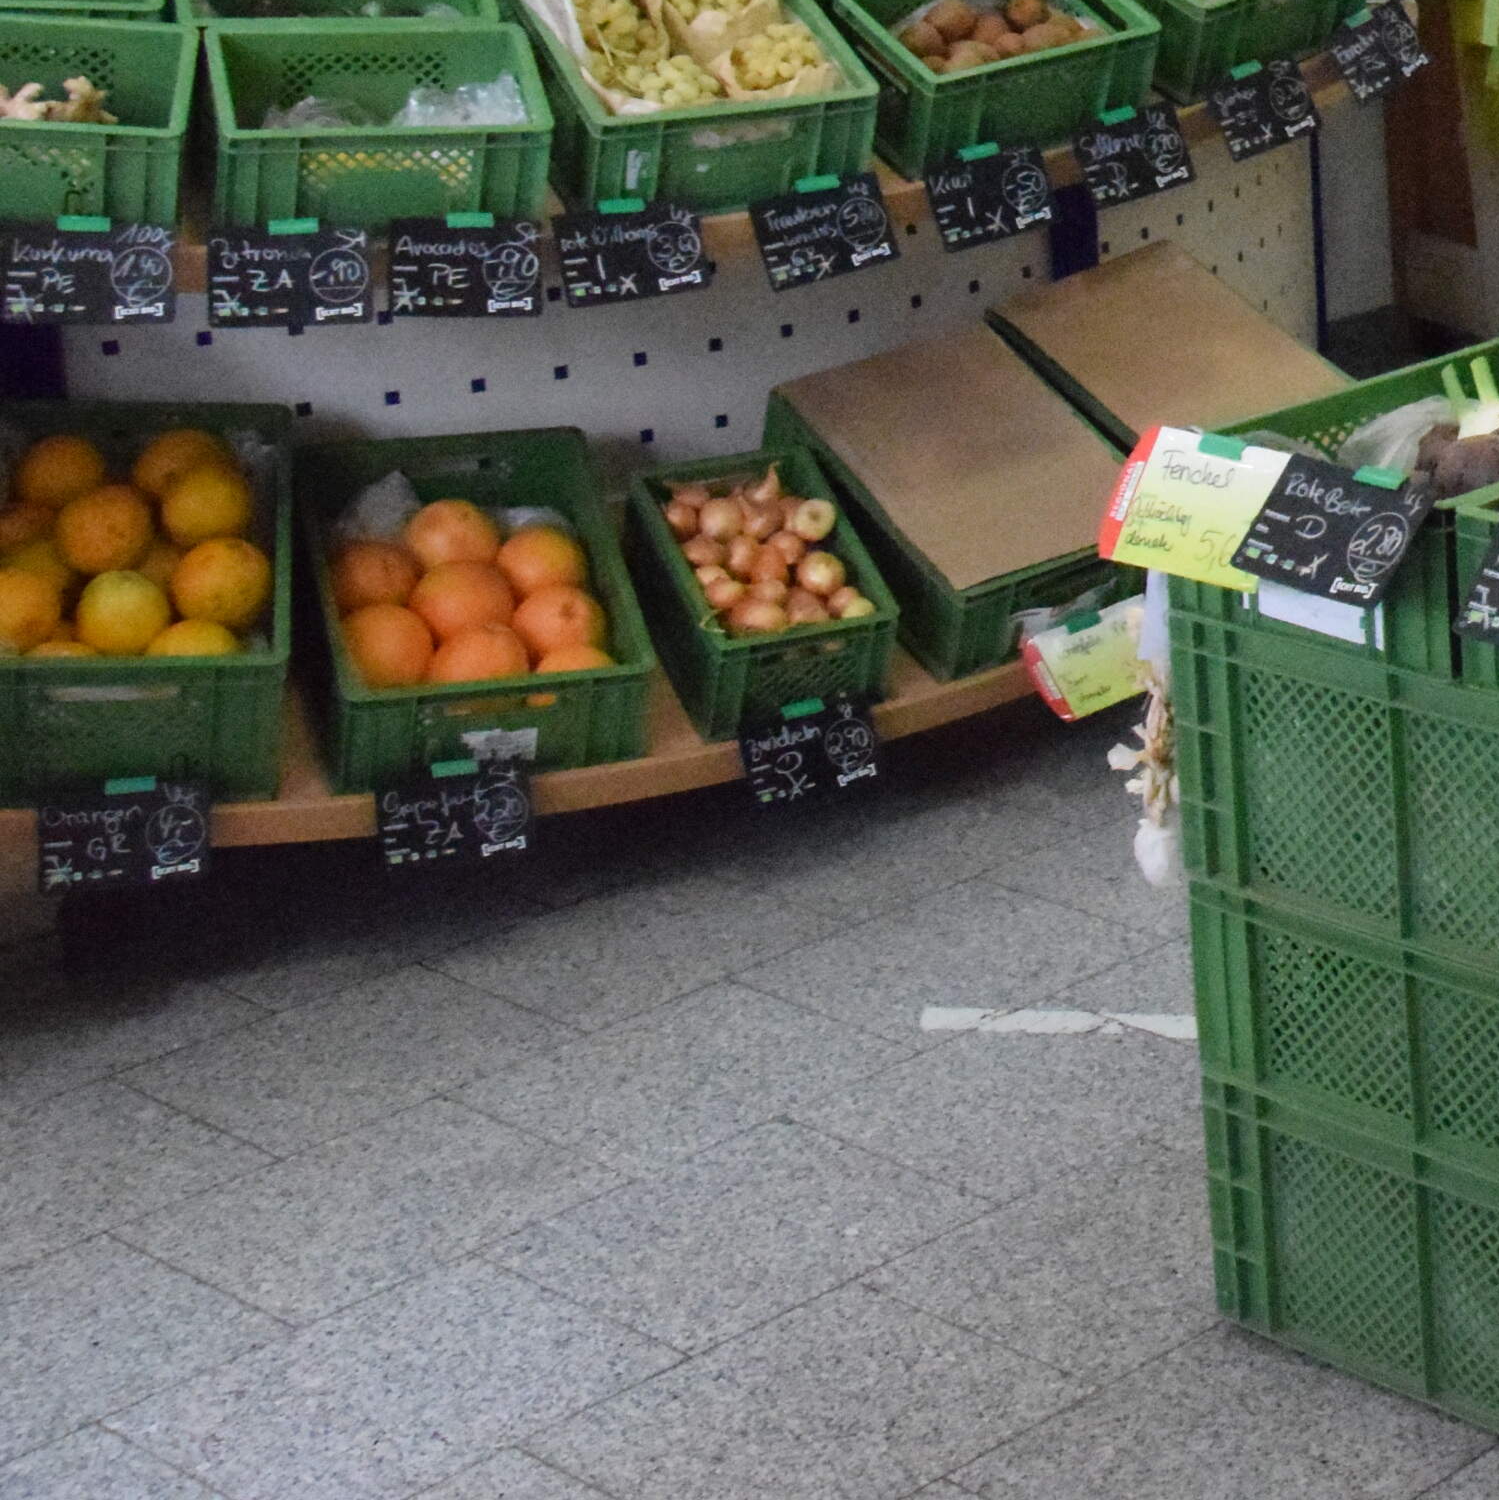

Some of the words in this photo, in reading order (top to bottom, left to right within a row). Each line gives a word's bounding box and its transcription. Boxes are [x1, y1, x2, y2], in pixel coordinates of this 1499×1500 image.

[12, 237, 113, 263] Kurkuma
[394, 234, 492, 258] Avocados
[427, 262, 473, 289] PE
[1161, 449, 1237, 489] Fenchel
[43, 804, 144, 835] Orangen
